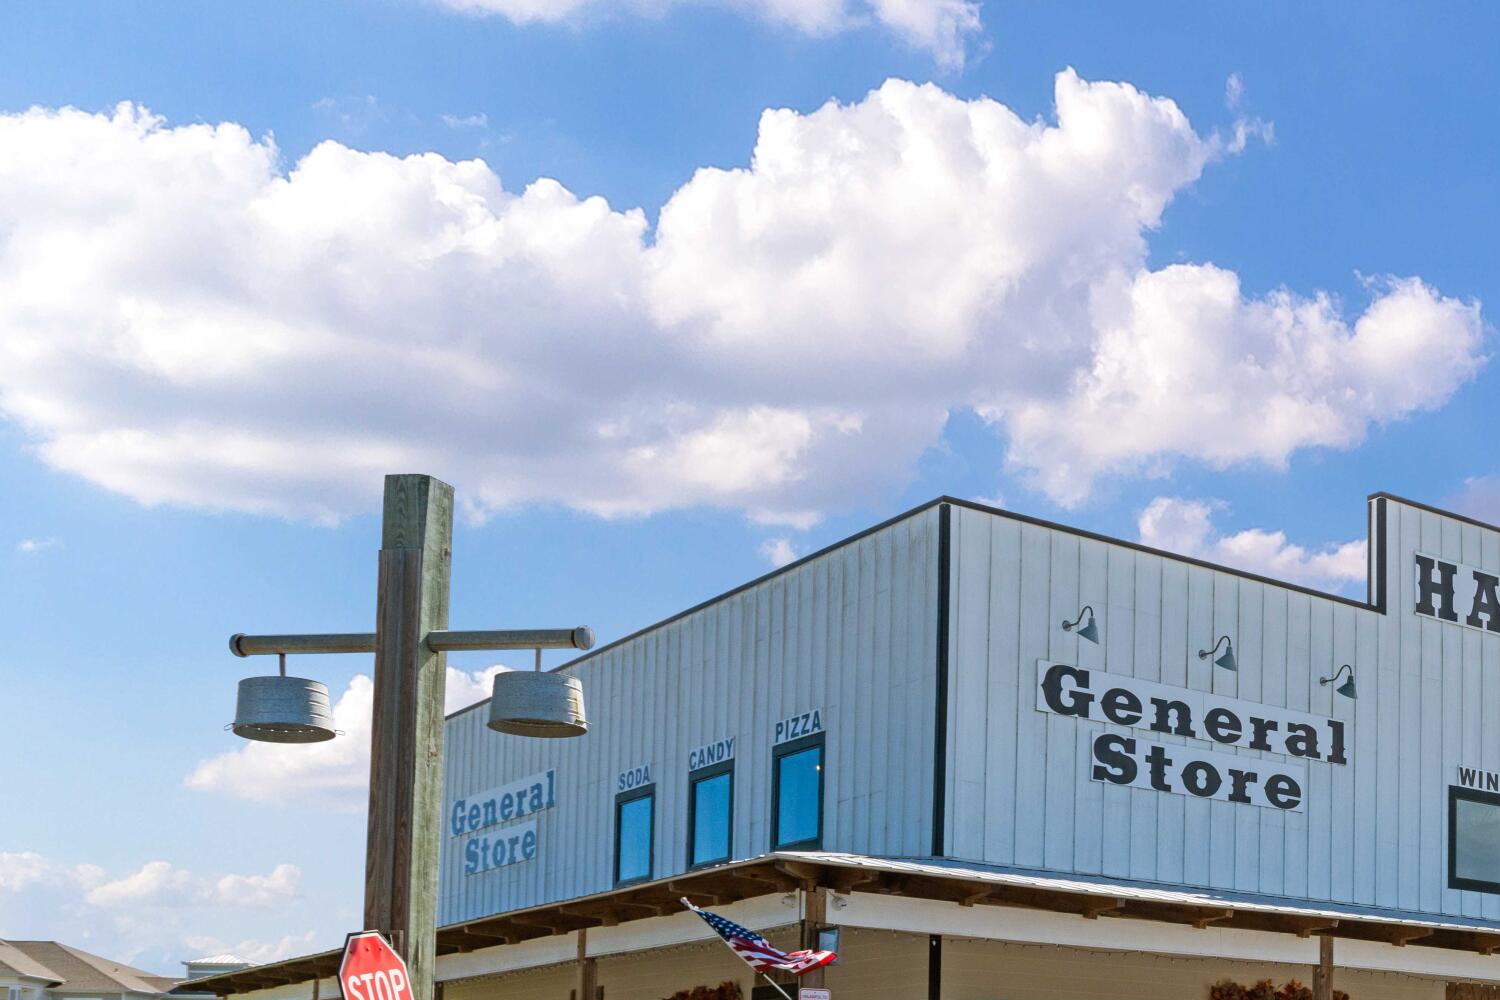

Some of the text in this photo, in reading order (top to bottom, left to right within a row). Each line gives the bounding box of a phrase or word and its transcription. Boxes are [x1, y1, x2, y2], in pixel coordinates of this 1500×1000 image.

[775, 709, 822, 743] PIZZA
[1041, 664, 1347, 765] General
[689, 737, 734, 770] CANDY
[1093, 733, 1302, 810] Store
[618, 764, 651, 791] SODA
[451, 769, 555, 836] General
[464, 829, 536, 875] Store
